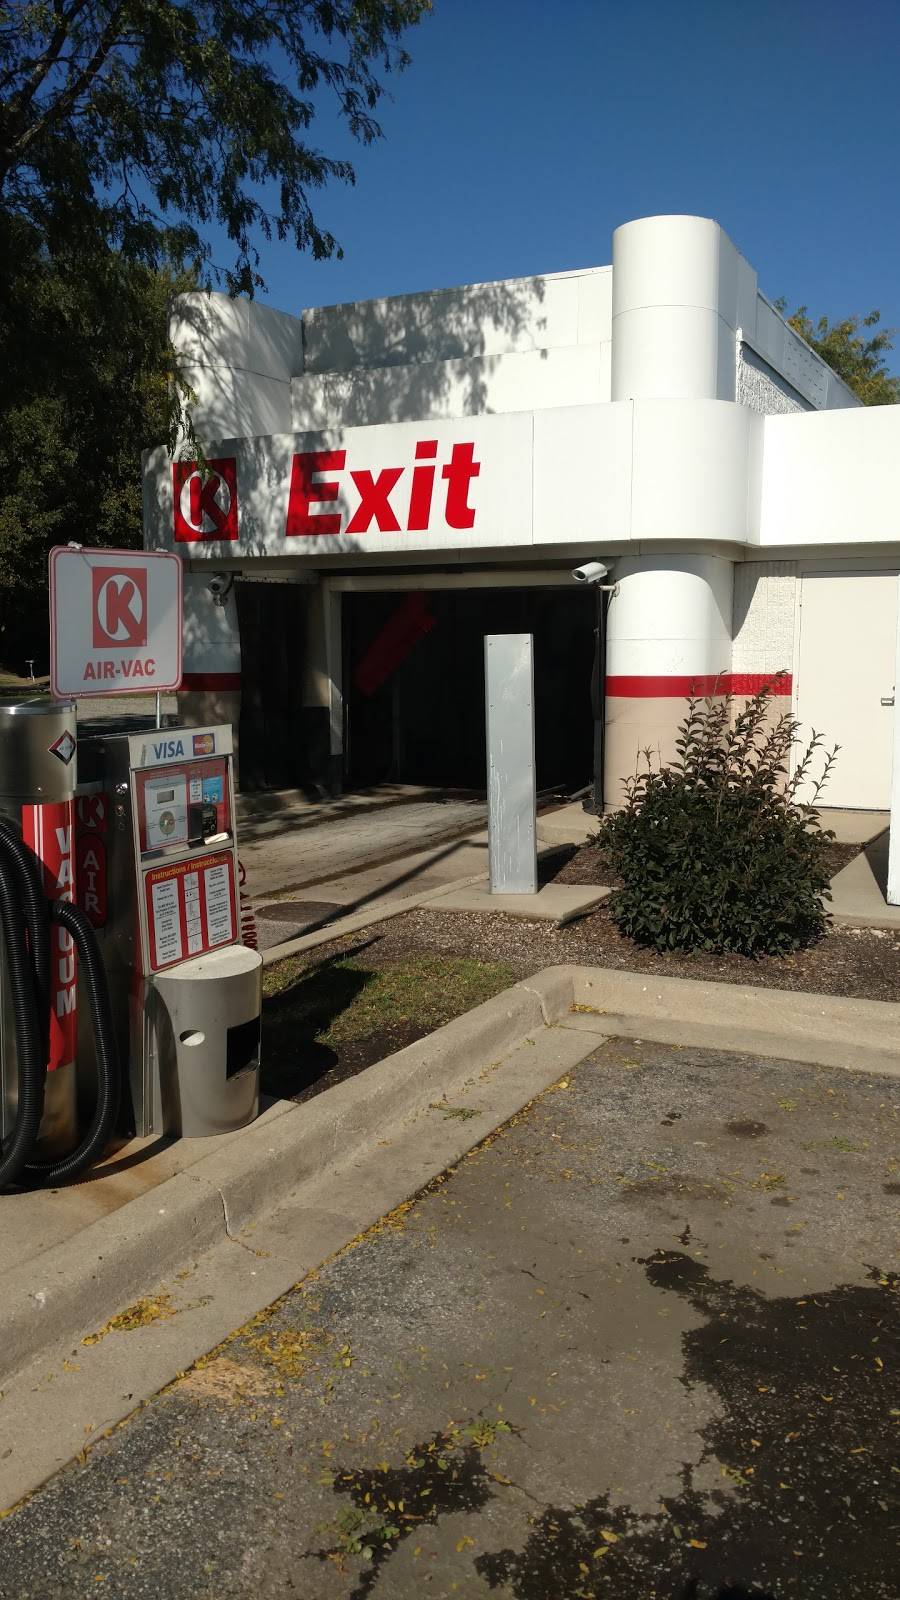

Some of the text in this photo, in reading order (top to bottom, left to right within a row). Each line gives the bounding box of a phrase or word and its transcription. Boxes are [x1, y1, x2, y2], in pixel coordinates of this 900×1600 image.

[286, 439, 481, 537] Exit
[83, 658, 156, 681] AIR-VAC
[153, 740, 185, 760] VISA
[82, 850, 102, 914] AIR
[151, 866, 186, 881] Instructions
